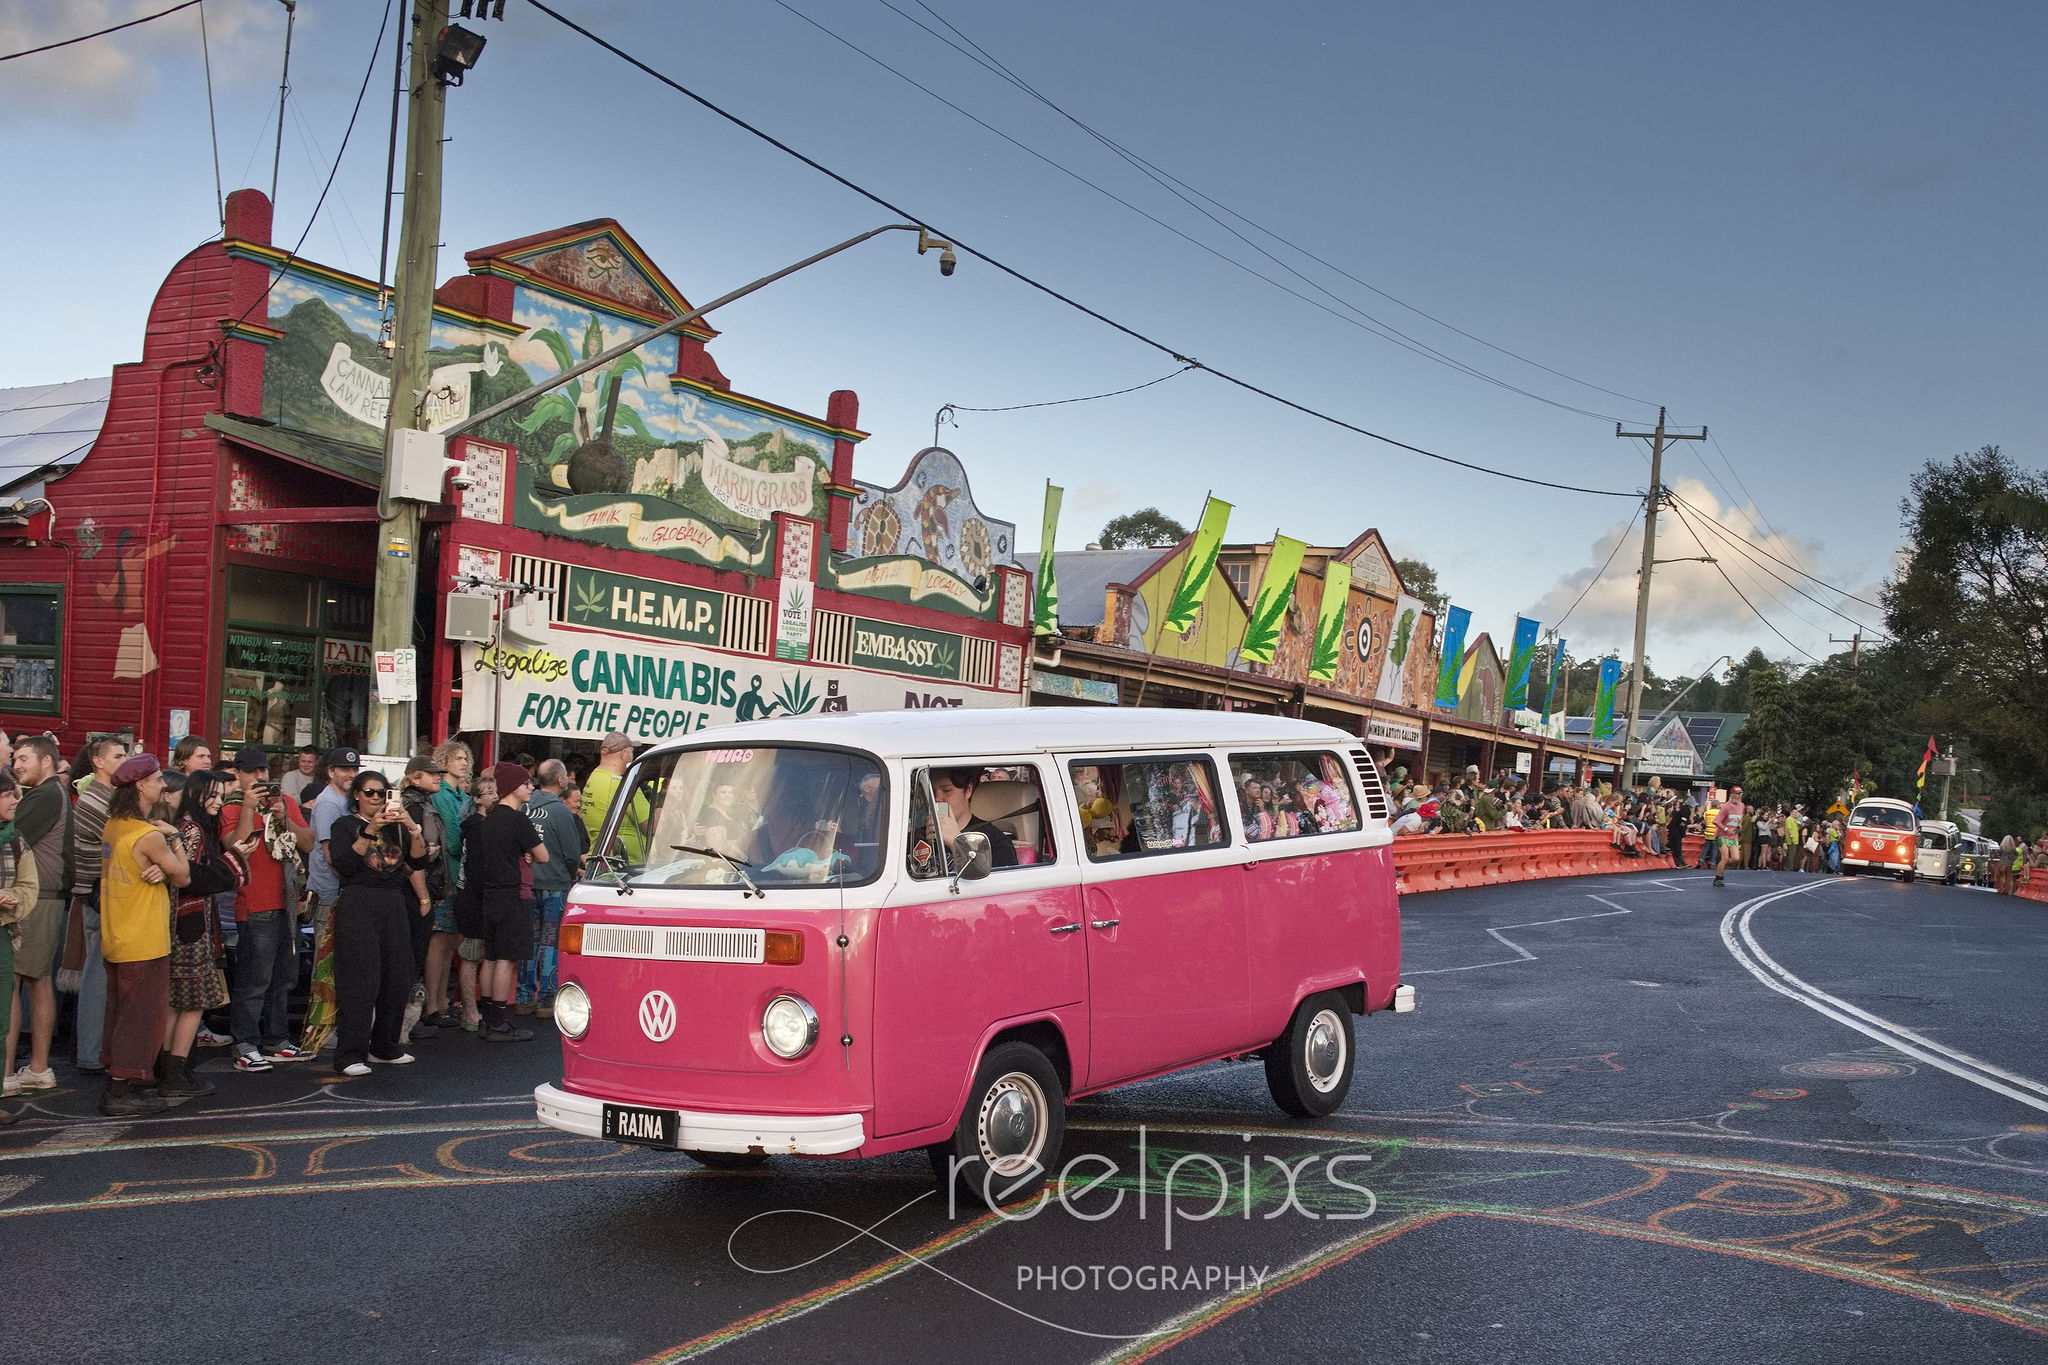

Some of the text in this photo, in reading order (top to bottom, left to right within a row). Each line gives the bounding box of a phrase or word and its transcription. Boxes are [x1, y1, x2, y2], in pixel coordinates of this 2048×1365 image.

[328, 376, 360, 406] LAW
[337, 359, 391, 399] CANNA
[710, 459, 808, 509] MARDI GRASS
[712, 485, 730, 503] FIRST
[734, 502, 763, 519] WEEKEND
[652, 525, 713, 549] GLOBALLY
[926, 574, 967, 597] LOCALLY
[611, 586, 715, 635] H.E.M.P.
[782, 609, 801, 620] VOTE
[229, 634, 316, 652] NIMBIN MDIGRASS
[241, 649, 257, 664] May
[855, 630, 938, 667] EMBASSY
[396, 652, 414, 665] 2P
[474, 648, 568, 683] Legalize
[571, 649, 738, 708] CANNABIS
[517, 692, 709, 738] FOR THE PEOPLE
[1401, 729, 1419, 743] GALLERY
[618, 1111, 664, 1140] RAINA
